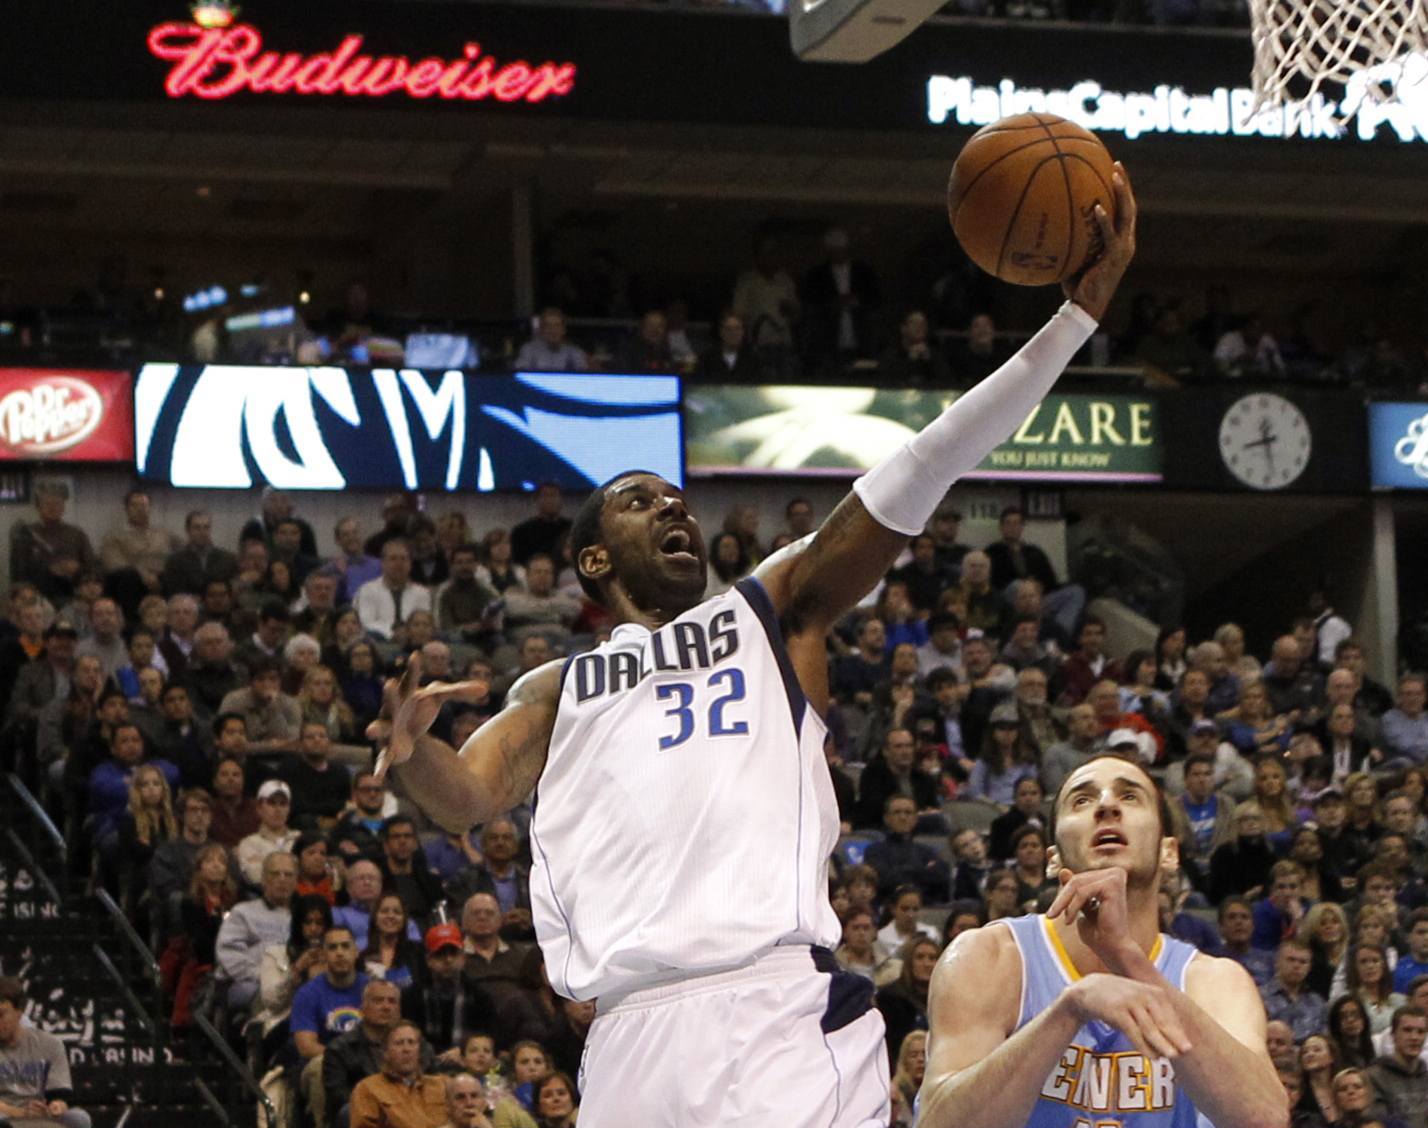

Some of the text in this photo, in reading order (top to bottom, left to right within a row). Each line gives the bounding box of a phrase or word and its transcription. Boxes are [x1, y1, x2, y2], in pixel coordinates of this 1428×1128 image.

[148, 22, 576, 101] Budweiser
[576, 608, 740, 706] DALLAS
[655, 667, 749, 753] 32
